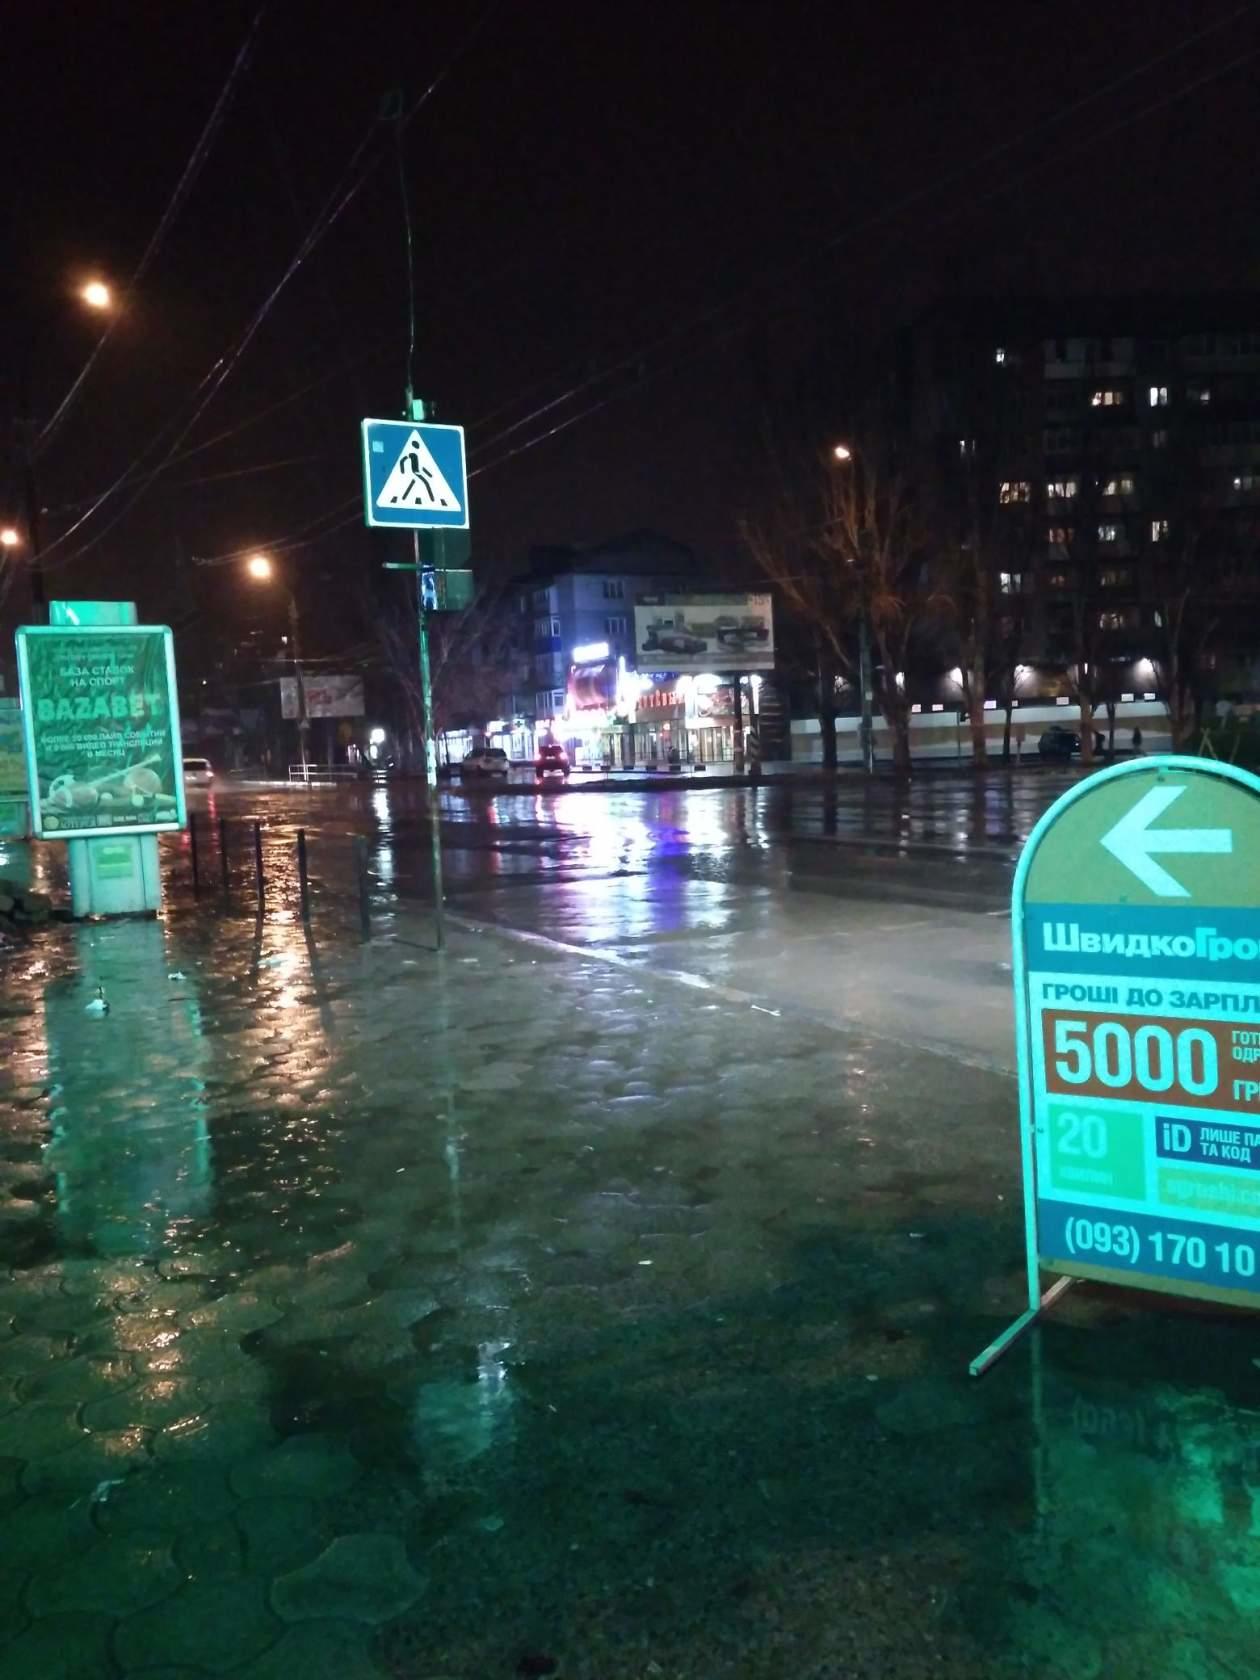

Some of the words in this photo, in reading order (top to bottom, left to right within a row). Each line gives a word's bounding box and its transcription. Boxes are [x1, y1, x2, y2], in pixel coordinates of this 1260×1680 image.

[71, 677, 87, 687] НА
[38, 693, 162, 720] BAZABET
[1043, 922, 1260, 961] ШвидкоГро
[1042, 983, 1118, 1004] ГРОШІ
[1126, 988, 1163, 1007] ДО
[1055, 1019, 1219, 1096] 5000
[1234, 1079, 1260, 1101] ГР
[1057, 1112, 1108, 1159] 20
[1163, 1122, 1192, 1153] iD
[1200, 1127, 1241, 1145] ЛИШЕ
[1200, 1142, 1218, 1157] ТА
[1221, 1144, 1251, 1163] КОД
[1065, 1216, 1140, 1264] (093)
[1149, 1231, 1206, 1268] 170
[1215, 1242, 1256, 1277] 10
